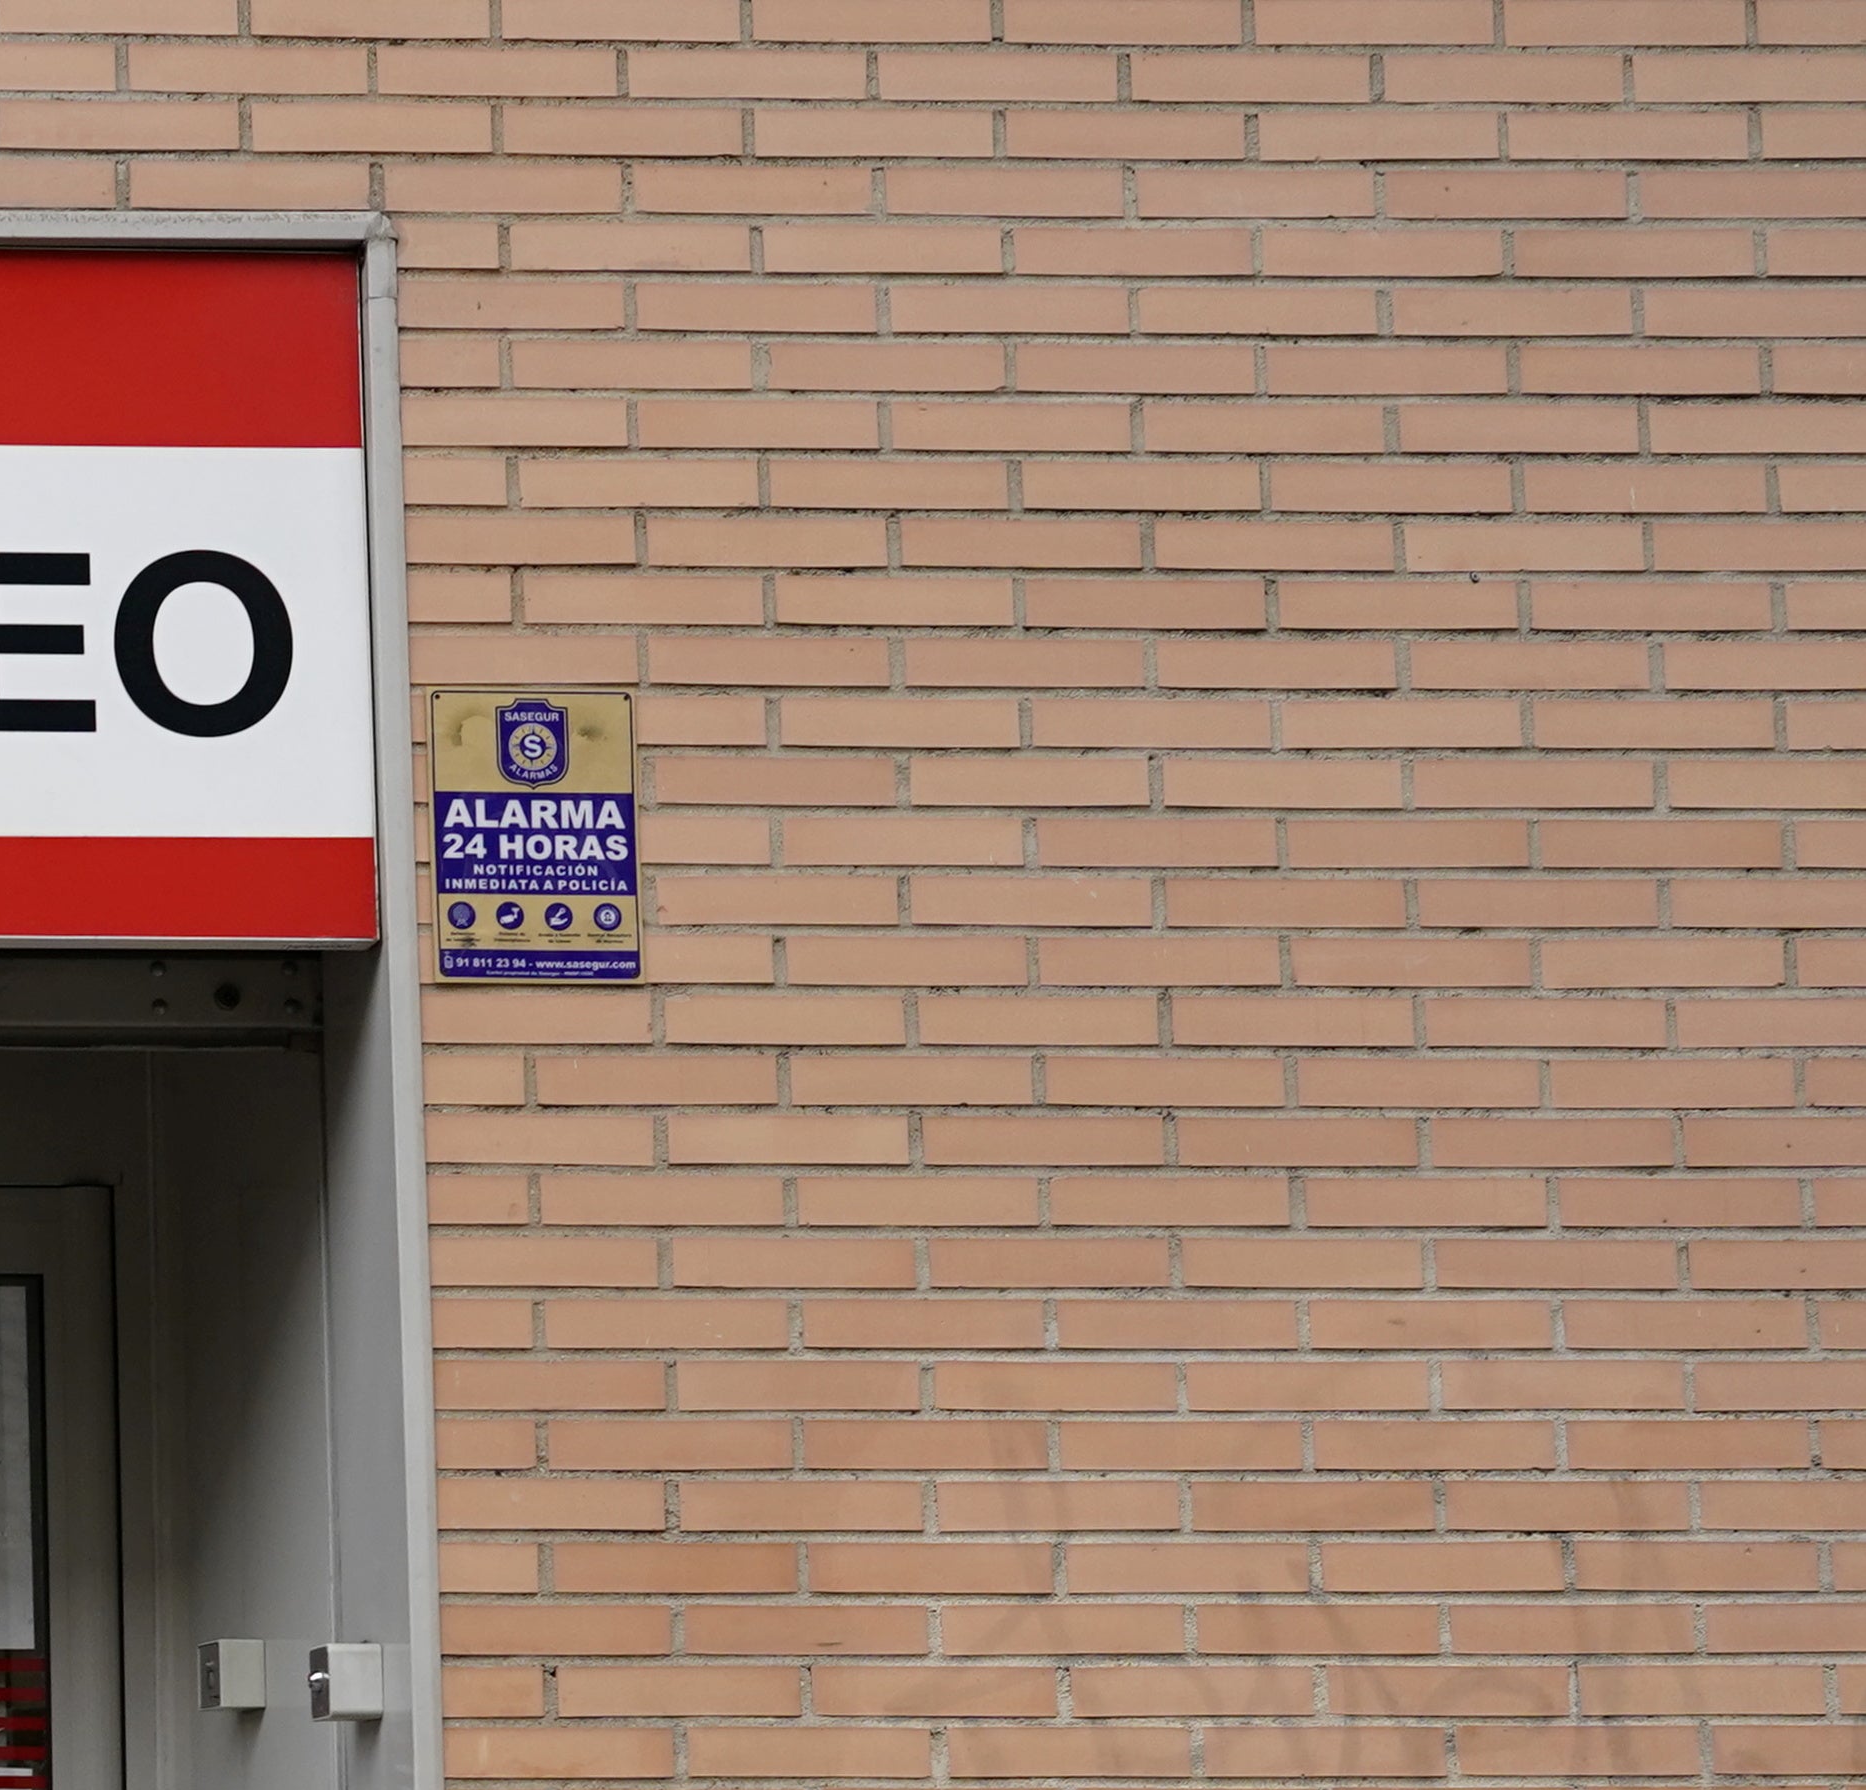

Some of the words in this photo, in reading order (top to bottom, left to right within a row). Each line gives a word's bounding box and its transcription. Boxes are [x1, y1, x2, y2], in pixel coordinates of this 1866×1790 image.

[505, 712, 559, 721] SASEGUR
[523, 735, 542, 758] S
[509, 763, 559, 780] ALARMAS
[444, 799, 625, 829] ALARMA
[443, 833, 487, 858] 24
[499, 835, 628, 860] HORAS
[474, 864, 598, 876] NOTIFICACIÓN
[446, 879, 539, 890] INMEDIATA
[543, 880, 553, 890] A
[558, 878, 627, 891] POLICÍA
[456, 957, 469, 967] 91
[473, 958, 492, 967] 811
[496, 958, 509, 968] 23
[536, 961, 636, 971] www.sasegur.com
